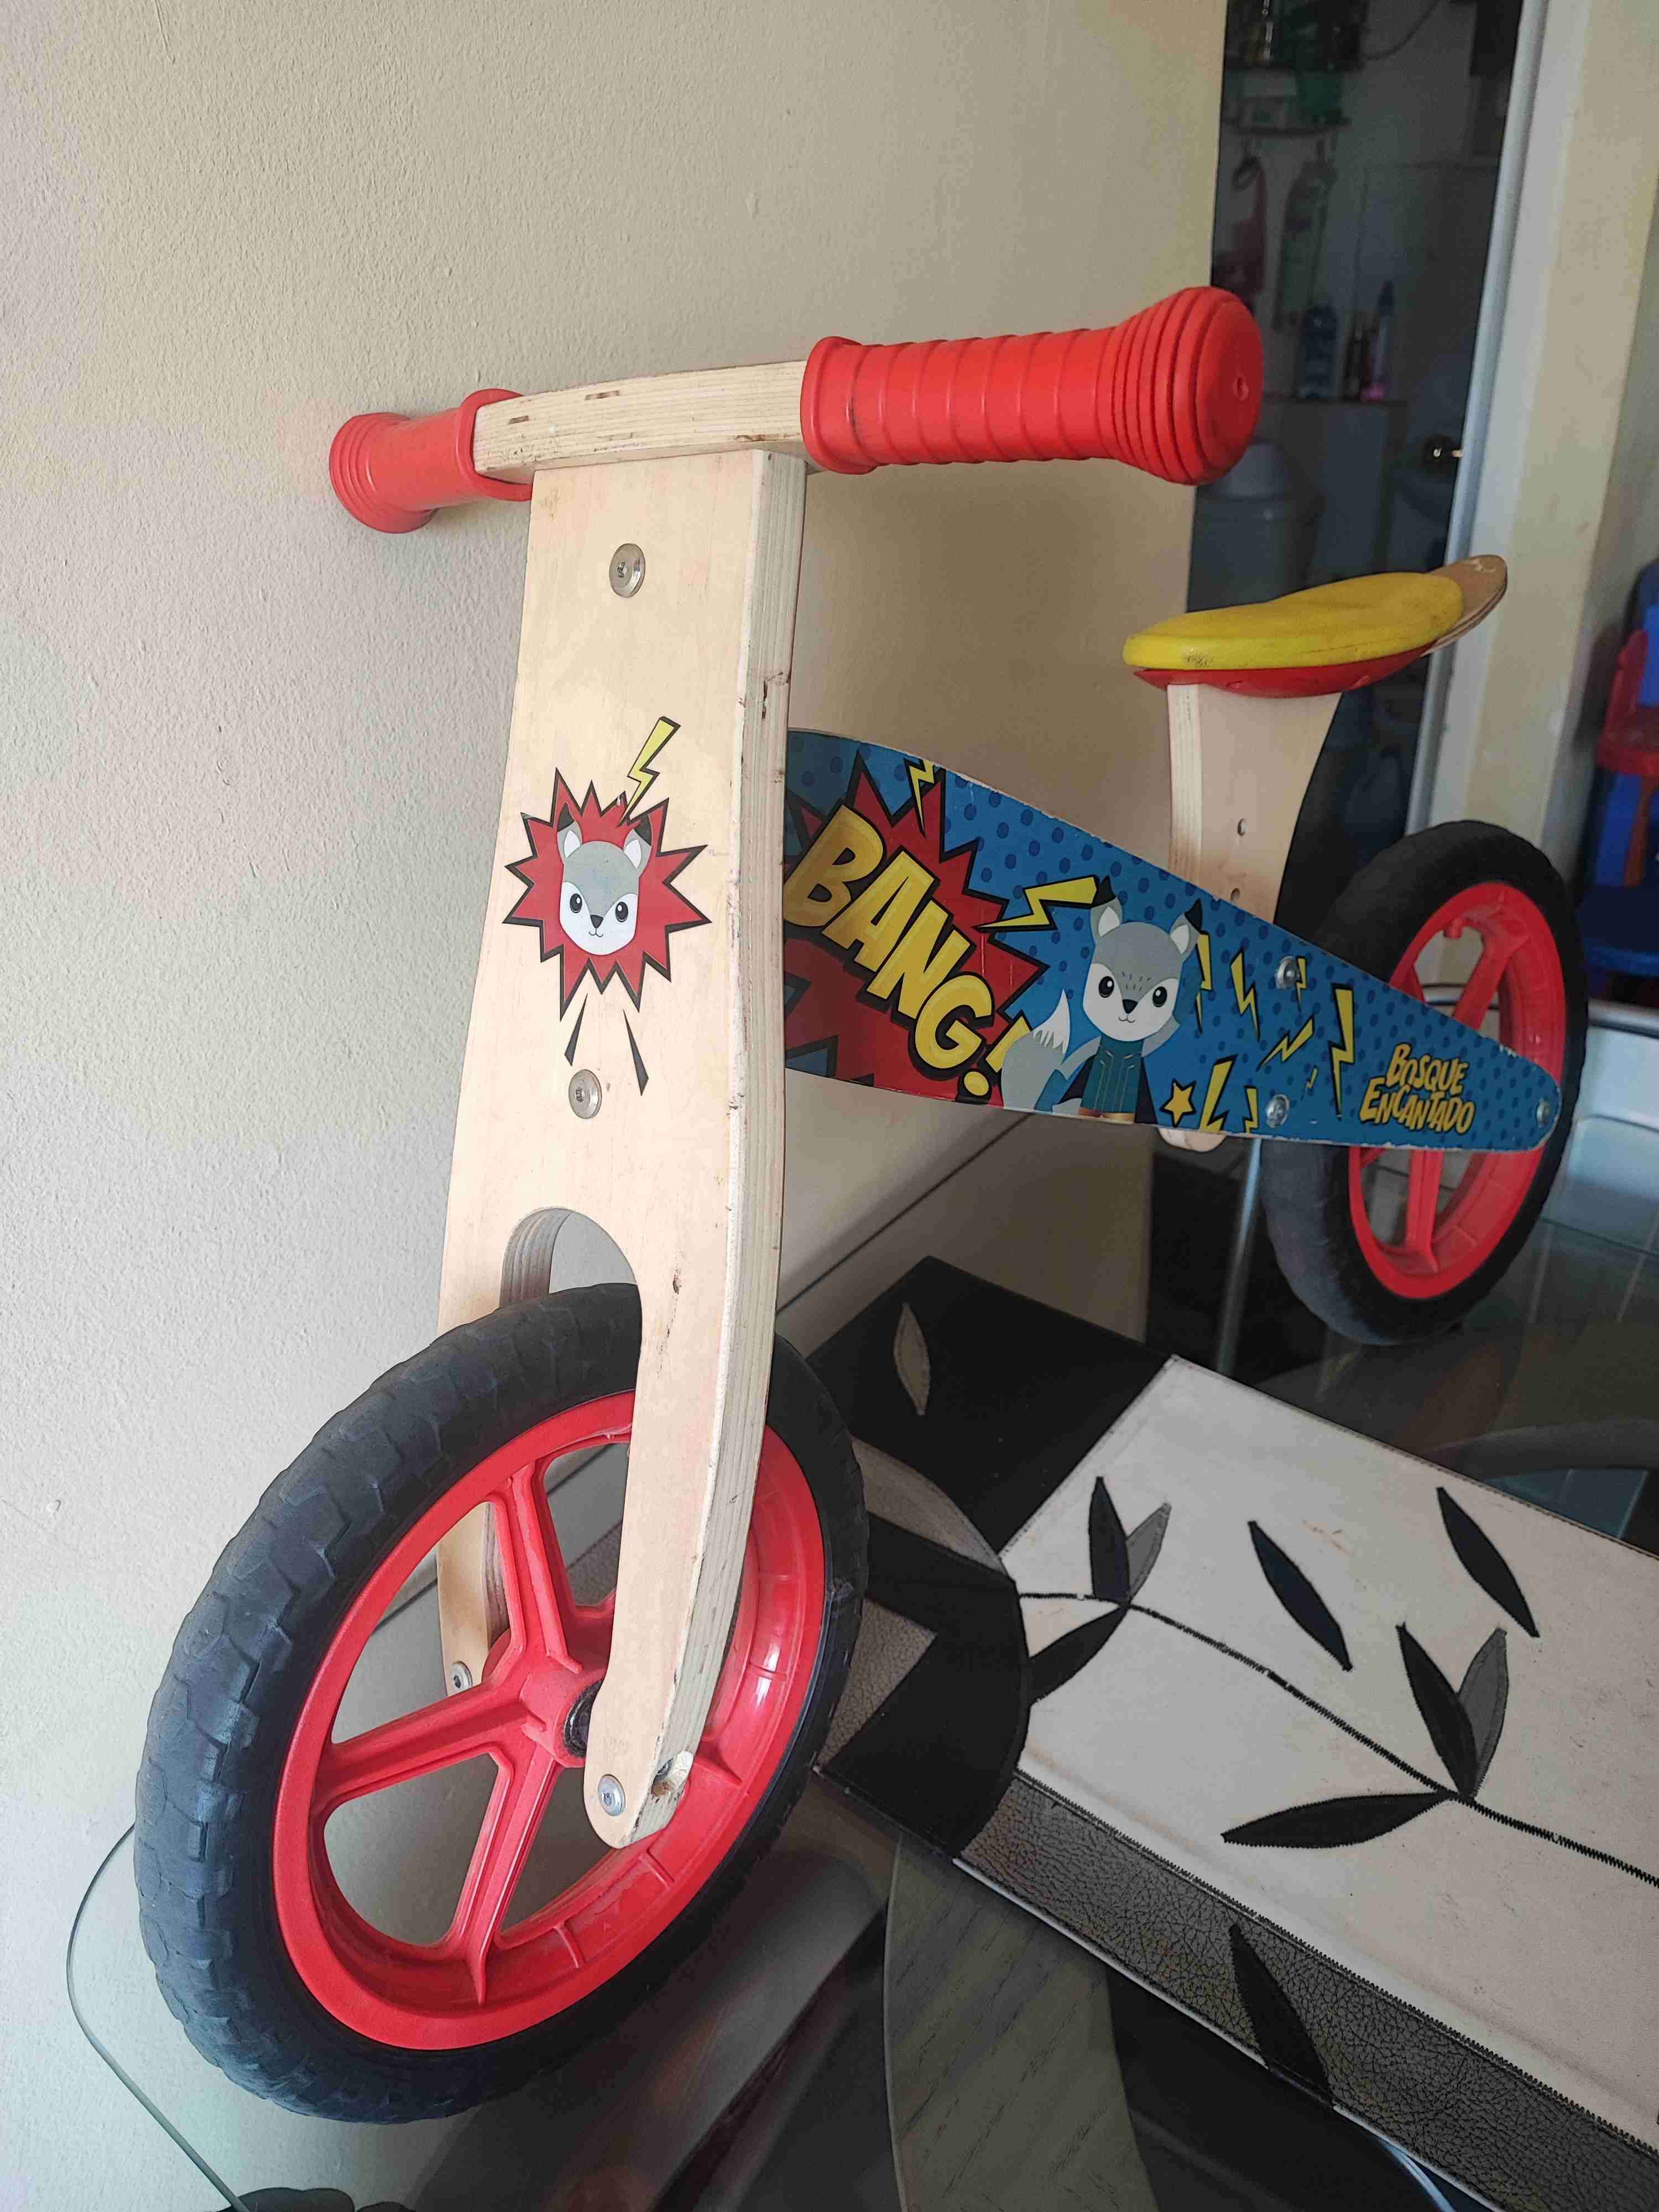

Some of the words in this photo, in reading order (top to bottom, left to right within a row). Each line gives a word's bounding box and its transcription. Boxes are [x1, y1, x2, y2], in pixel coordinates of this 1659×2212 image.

[782, 800, 1032, 1098] BANG!
[1385, 1043, 1469, 1095] BOSQUE
[1359, 1077, 1476, 1134] ENCANTADO
